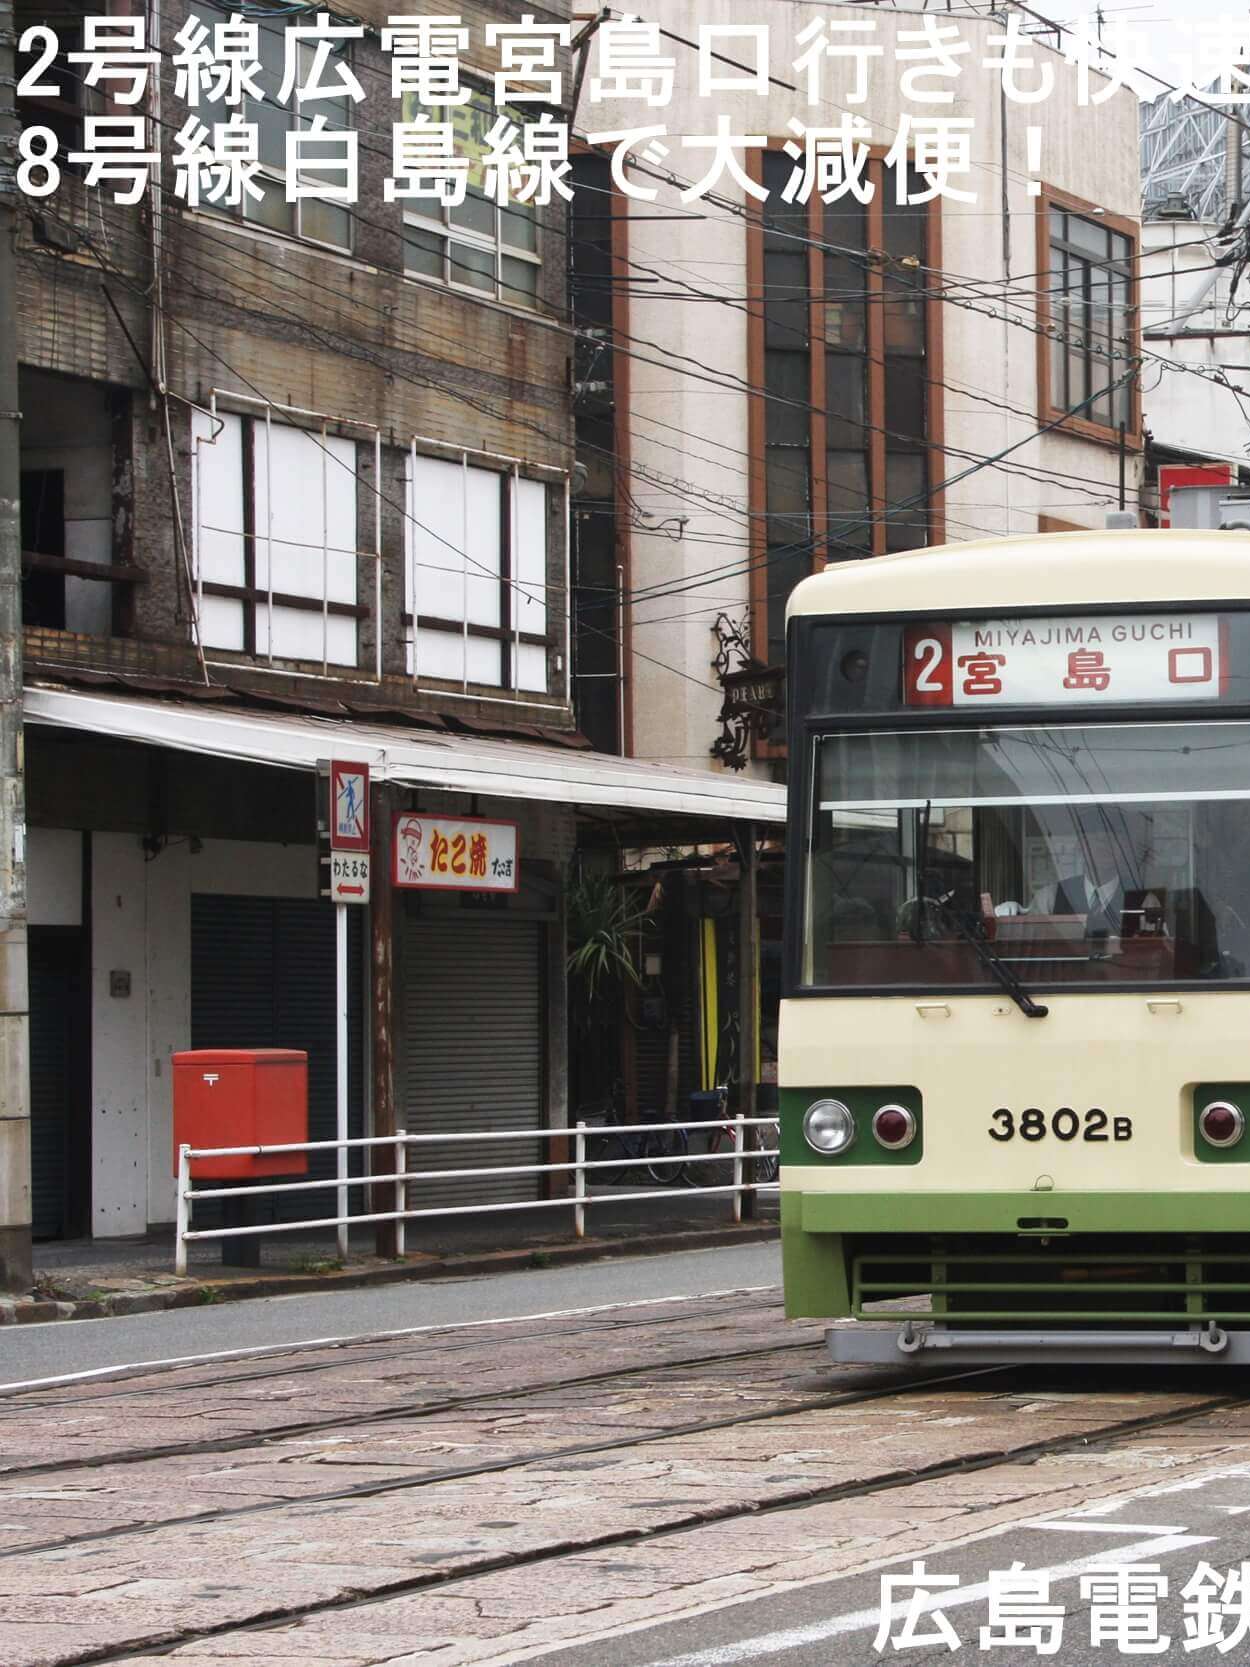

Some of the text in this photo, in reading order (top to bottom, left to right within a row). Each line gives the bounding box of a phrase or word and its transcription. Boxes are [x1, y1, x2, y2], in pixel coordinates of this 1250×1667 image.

[975, 623, 1193, 647] MIYAJIMA GUCHI
[914, 638, 944, 693] 2
[957, 646, 1212, 696] 宮島口
[333, 858, 368, 879] わたるな
[429, 828, 488, 878] たこ焼
